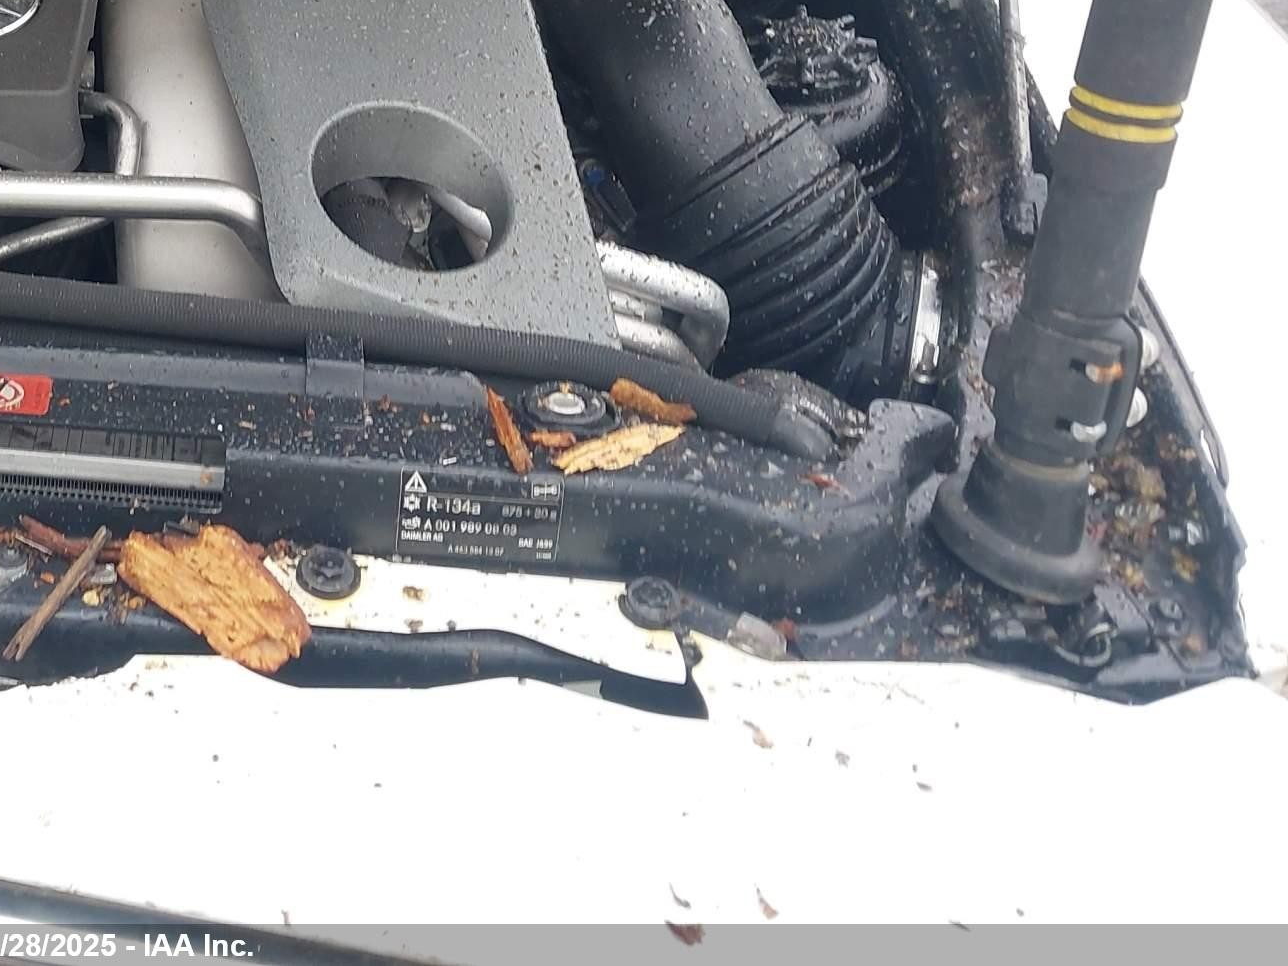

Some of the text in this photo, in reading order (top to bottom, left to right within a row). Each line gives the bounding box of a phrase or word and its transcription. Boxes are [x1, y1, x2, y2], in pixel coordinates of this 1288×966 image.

[426, 496, 481, 515] R-134a
[424, 518, 432, 531] A
[435, 519, 456, 532] 001
[401, 530, 432, 542] DAIMLER
